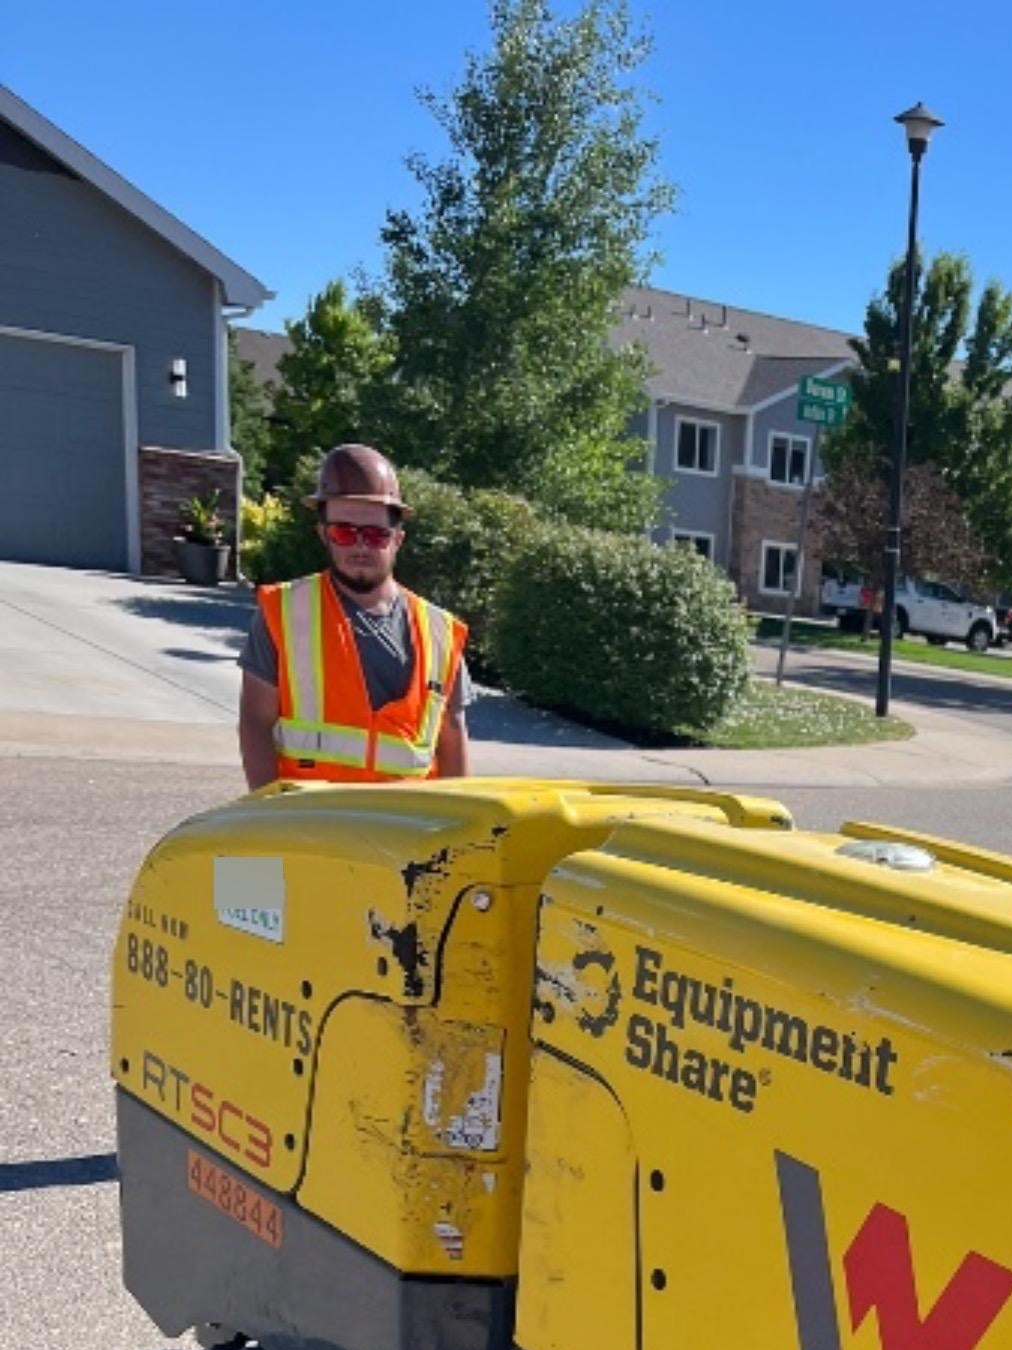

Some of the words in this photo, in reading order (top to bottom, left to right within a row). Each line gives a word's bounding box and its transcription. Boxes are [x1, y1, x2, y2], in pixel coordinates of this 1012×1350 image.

[127, 932, 313, 1057] 888-80-RENTS
[632, 945, 898, 1096] Equipment
[143, 1050, 273, 1169] RTSC3
[190, 1156, 280, 1243] 448844
